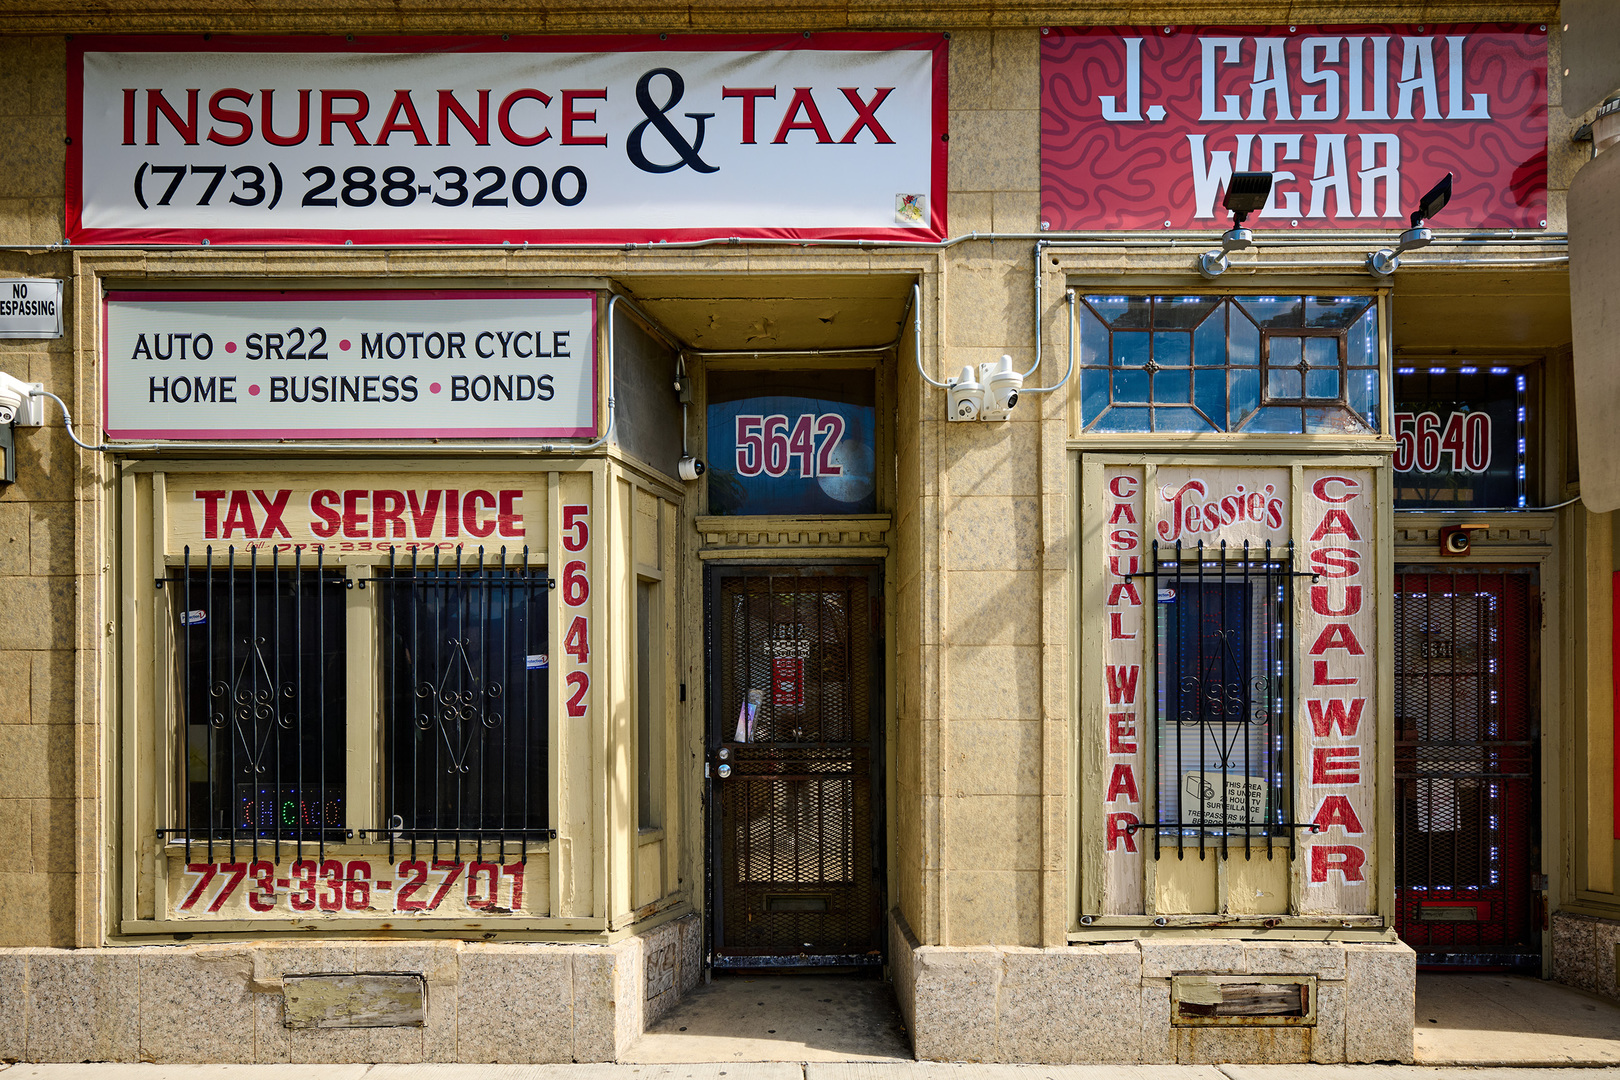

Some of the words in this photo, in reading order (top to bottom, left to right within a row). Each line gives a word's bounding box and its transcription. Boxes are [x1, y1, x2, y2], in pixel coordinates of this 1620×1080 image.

[1098, 37, 1168, 122] J.
[1198, 36, 1491, 121] CASUAL
[121, 88, 609, 147] INSURANCE
[626, 67, 721, 174] &
[722, 85, 897, 145] TAX
[134, 161, 284, 211] (773)
[301, 164, 588, 209] 288-3200
[1185, 133, 1404, 219] WEAR
[0, 300, 55, 316] ESPASSING
[12, 283, 28, 299] NO
[131, 332, 214, 361] AUTO
[245, 326, 329, 361] SR22
[360, 332, 466, 360] MOTOR
[474, 330, 571, 358] CYCLE
[149, 375, 237, 404] HOME
[269, 374, 419, 404] BUSINESS
[451, 374, 555, 403] BONDS
[735, 413, 845, 478] 5642
[1393, 411, 1491, 473] 5640
[195, 489, 294, 540] TAX
[309, 489, 527, 540] SERVICE
[1157, 479, 1284, 543] Jessie's
[1106, 475, 1143, 641] CASUAL
[1309, 475, 1366, 687] CASUAL
[562, 504, 591, 718] 5642
[1106, 663, 1142, 855] WEAR
[244, 801, 338, 825] CHCAGO
[1305, 697, 1367, 887] WEAR
[175, 860, 527, 915] 773-336-2701
